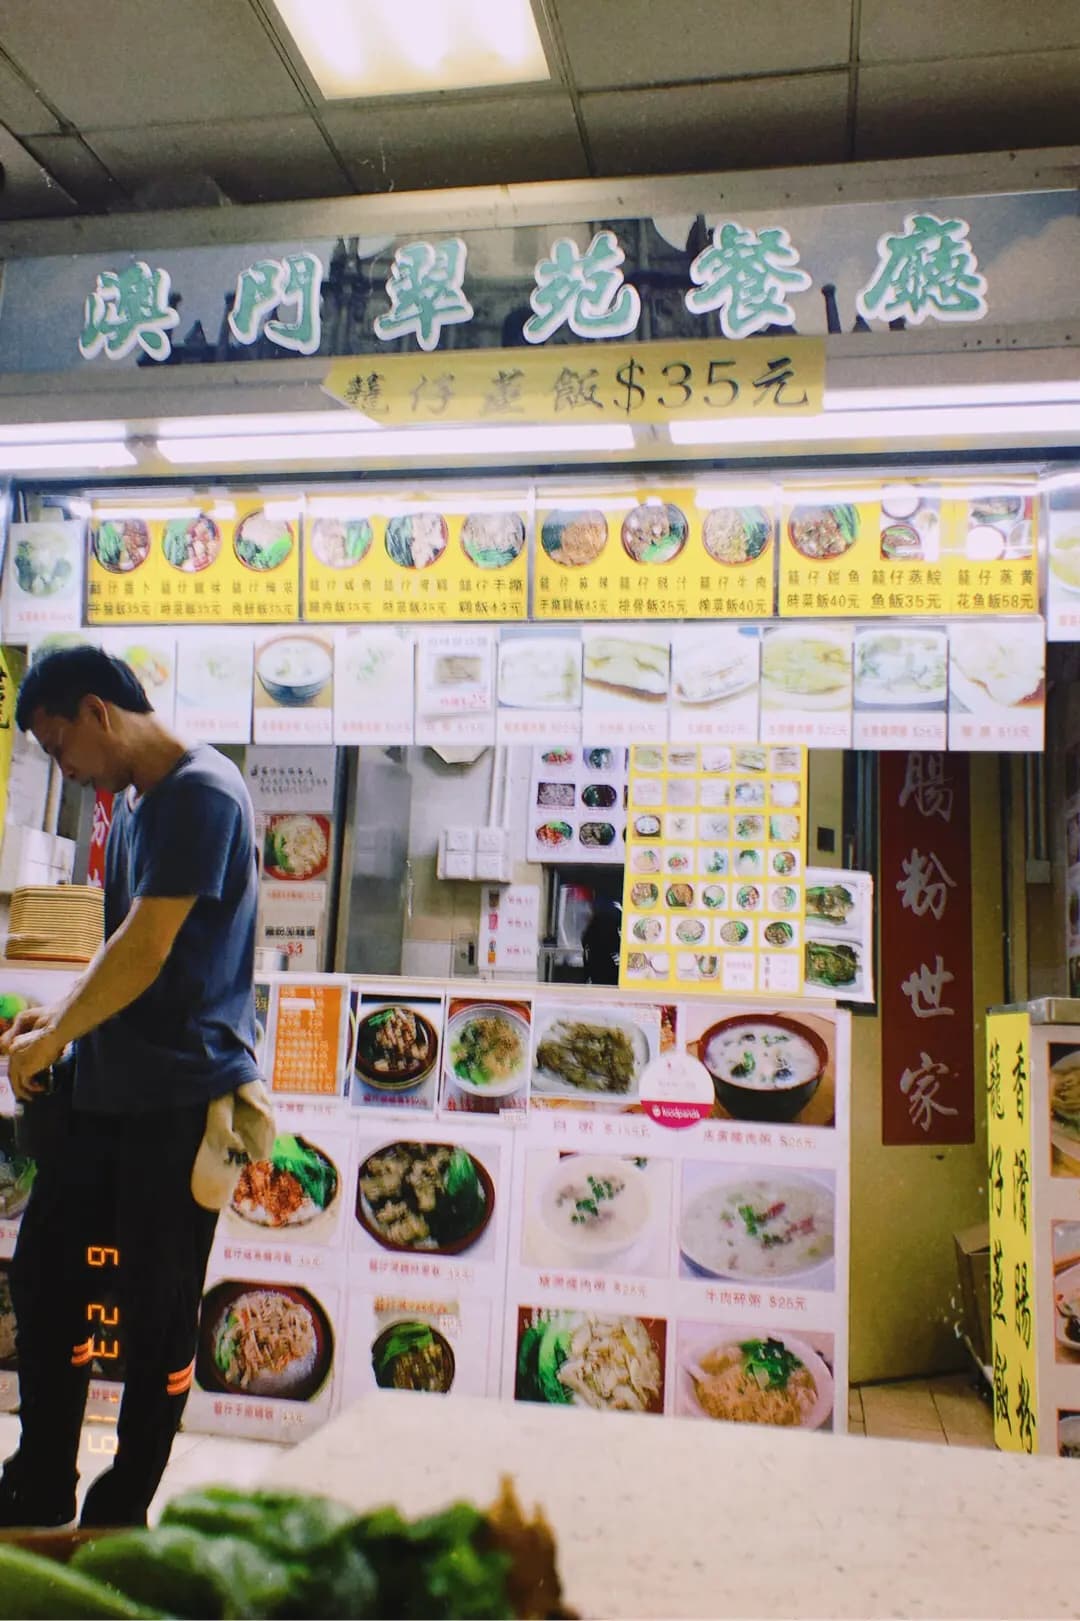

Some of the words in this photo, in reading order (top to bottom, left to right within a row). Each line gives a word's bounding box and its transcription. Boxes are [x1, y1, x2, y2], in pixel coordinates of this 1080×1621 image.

[79, 213, 989, 361] 澳門翠苑餐廳
[895, 750, 959, 1133] 腸粉世家
[661, 1105, 701, 1120] foodpanda
[1011, 1044, 1037, 1456] 香滑腸粉
